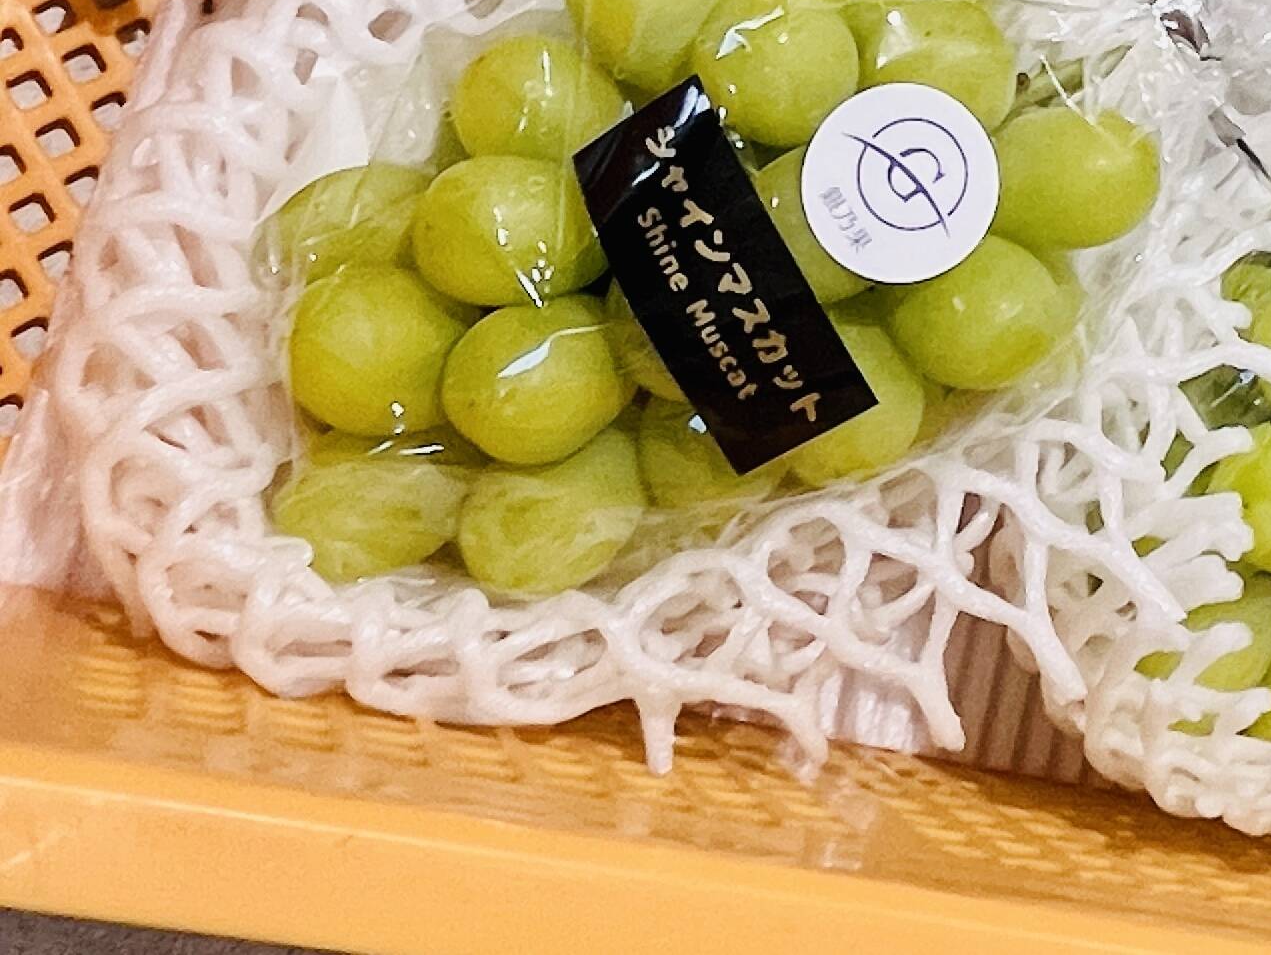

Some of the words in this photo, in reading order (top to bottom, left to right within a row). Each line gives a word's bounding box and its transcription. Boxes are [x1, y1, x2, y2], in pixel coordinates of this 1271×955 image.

[637, 207, 690, 292] Shine
[686, 299, 758, 400] Muscat
[645, 125, 822, 422] シャインマスカット
